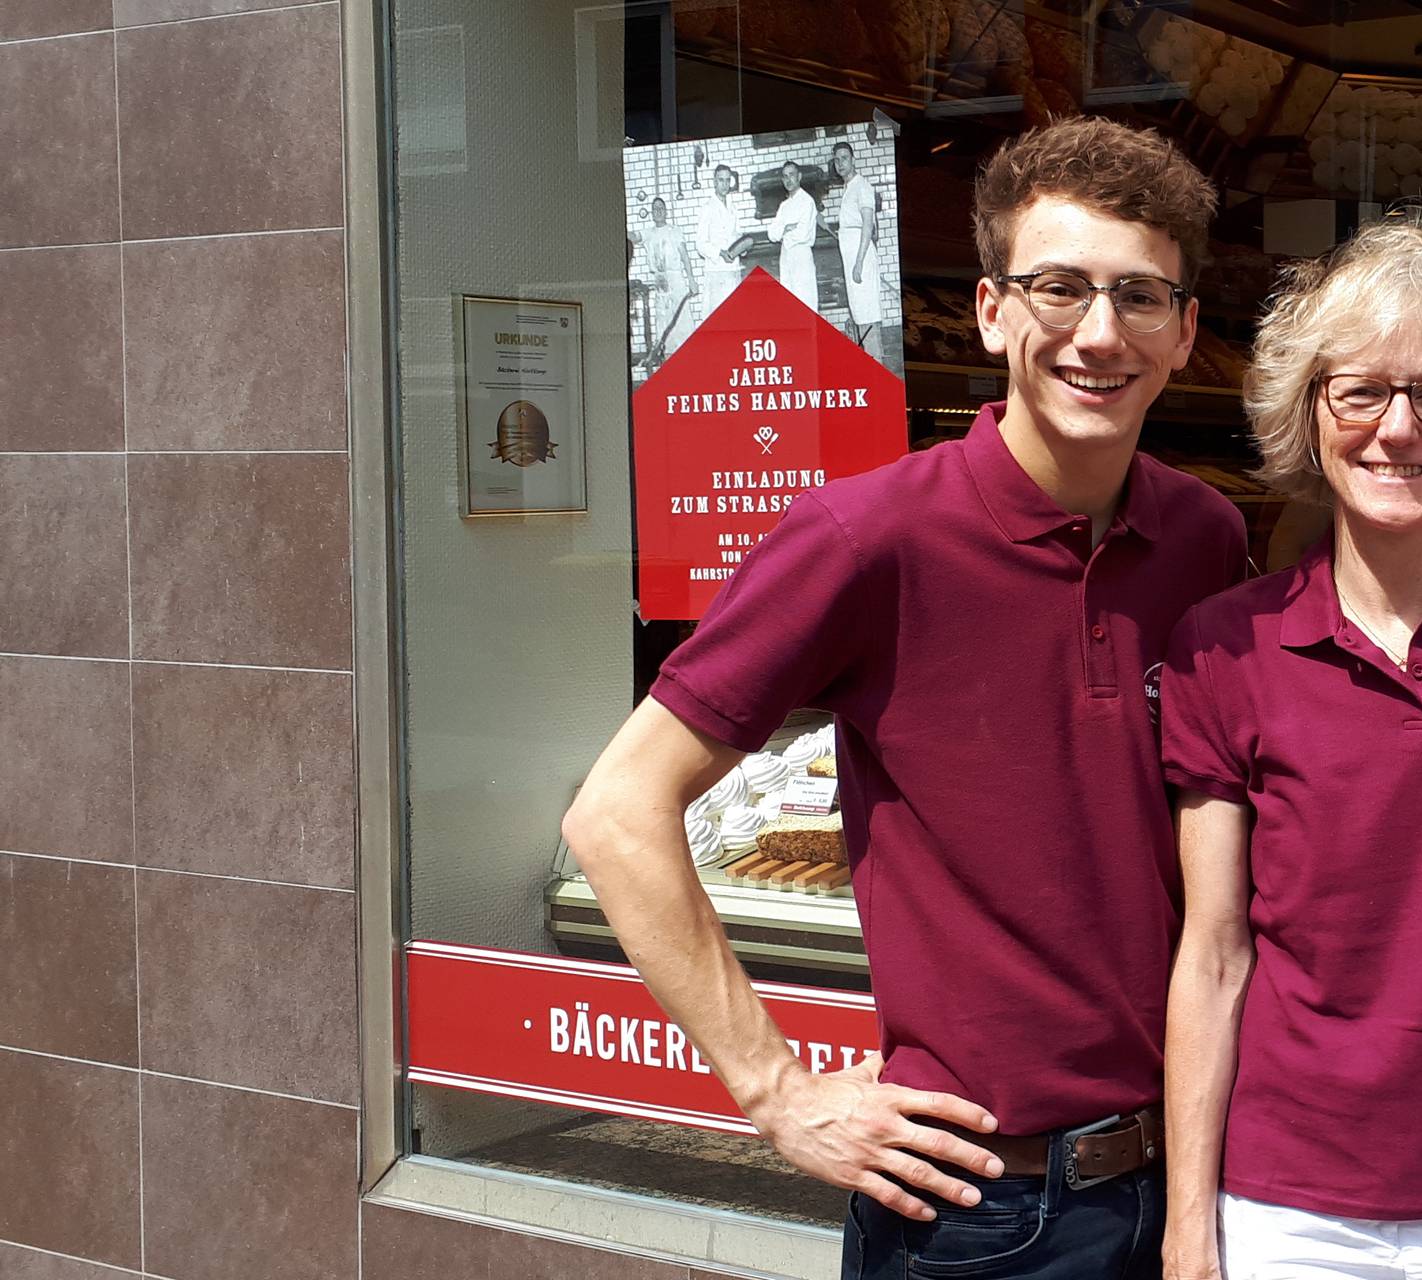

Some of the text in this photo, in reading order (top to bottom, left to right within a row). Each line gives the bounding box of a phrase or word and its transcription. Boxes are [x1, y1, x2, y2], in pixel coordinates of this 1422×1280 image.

[495, 332, 549, 347] URKUNDE
[743, 339, 776, 362] 150
[729, 366, 793, 387] JAHRE
[667, 388, 868, 414] FEINES HANDWERK
[712, 469, 826, 490] EINLADUNG
[671, 494, 800, 514] ZUM STRASS
[718, 533, 733, 546] AM
[737, 533, 754, 546] 10.
[721, 550, 742, 563] VON
